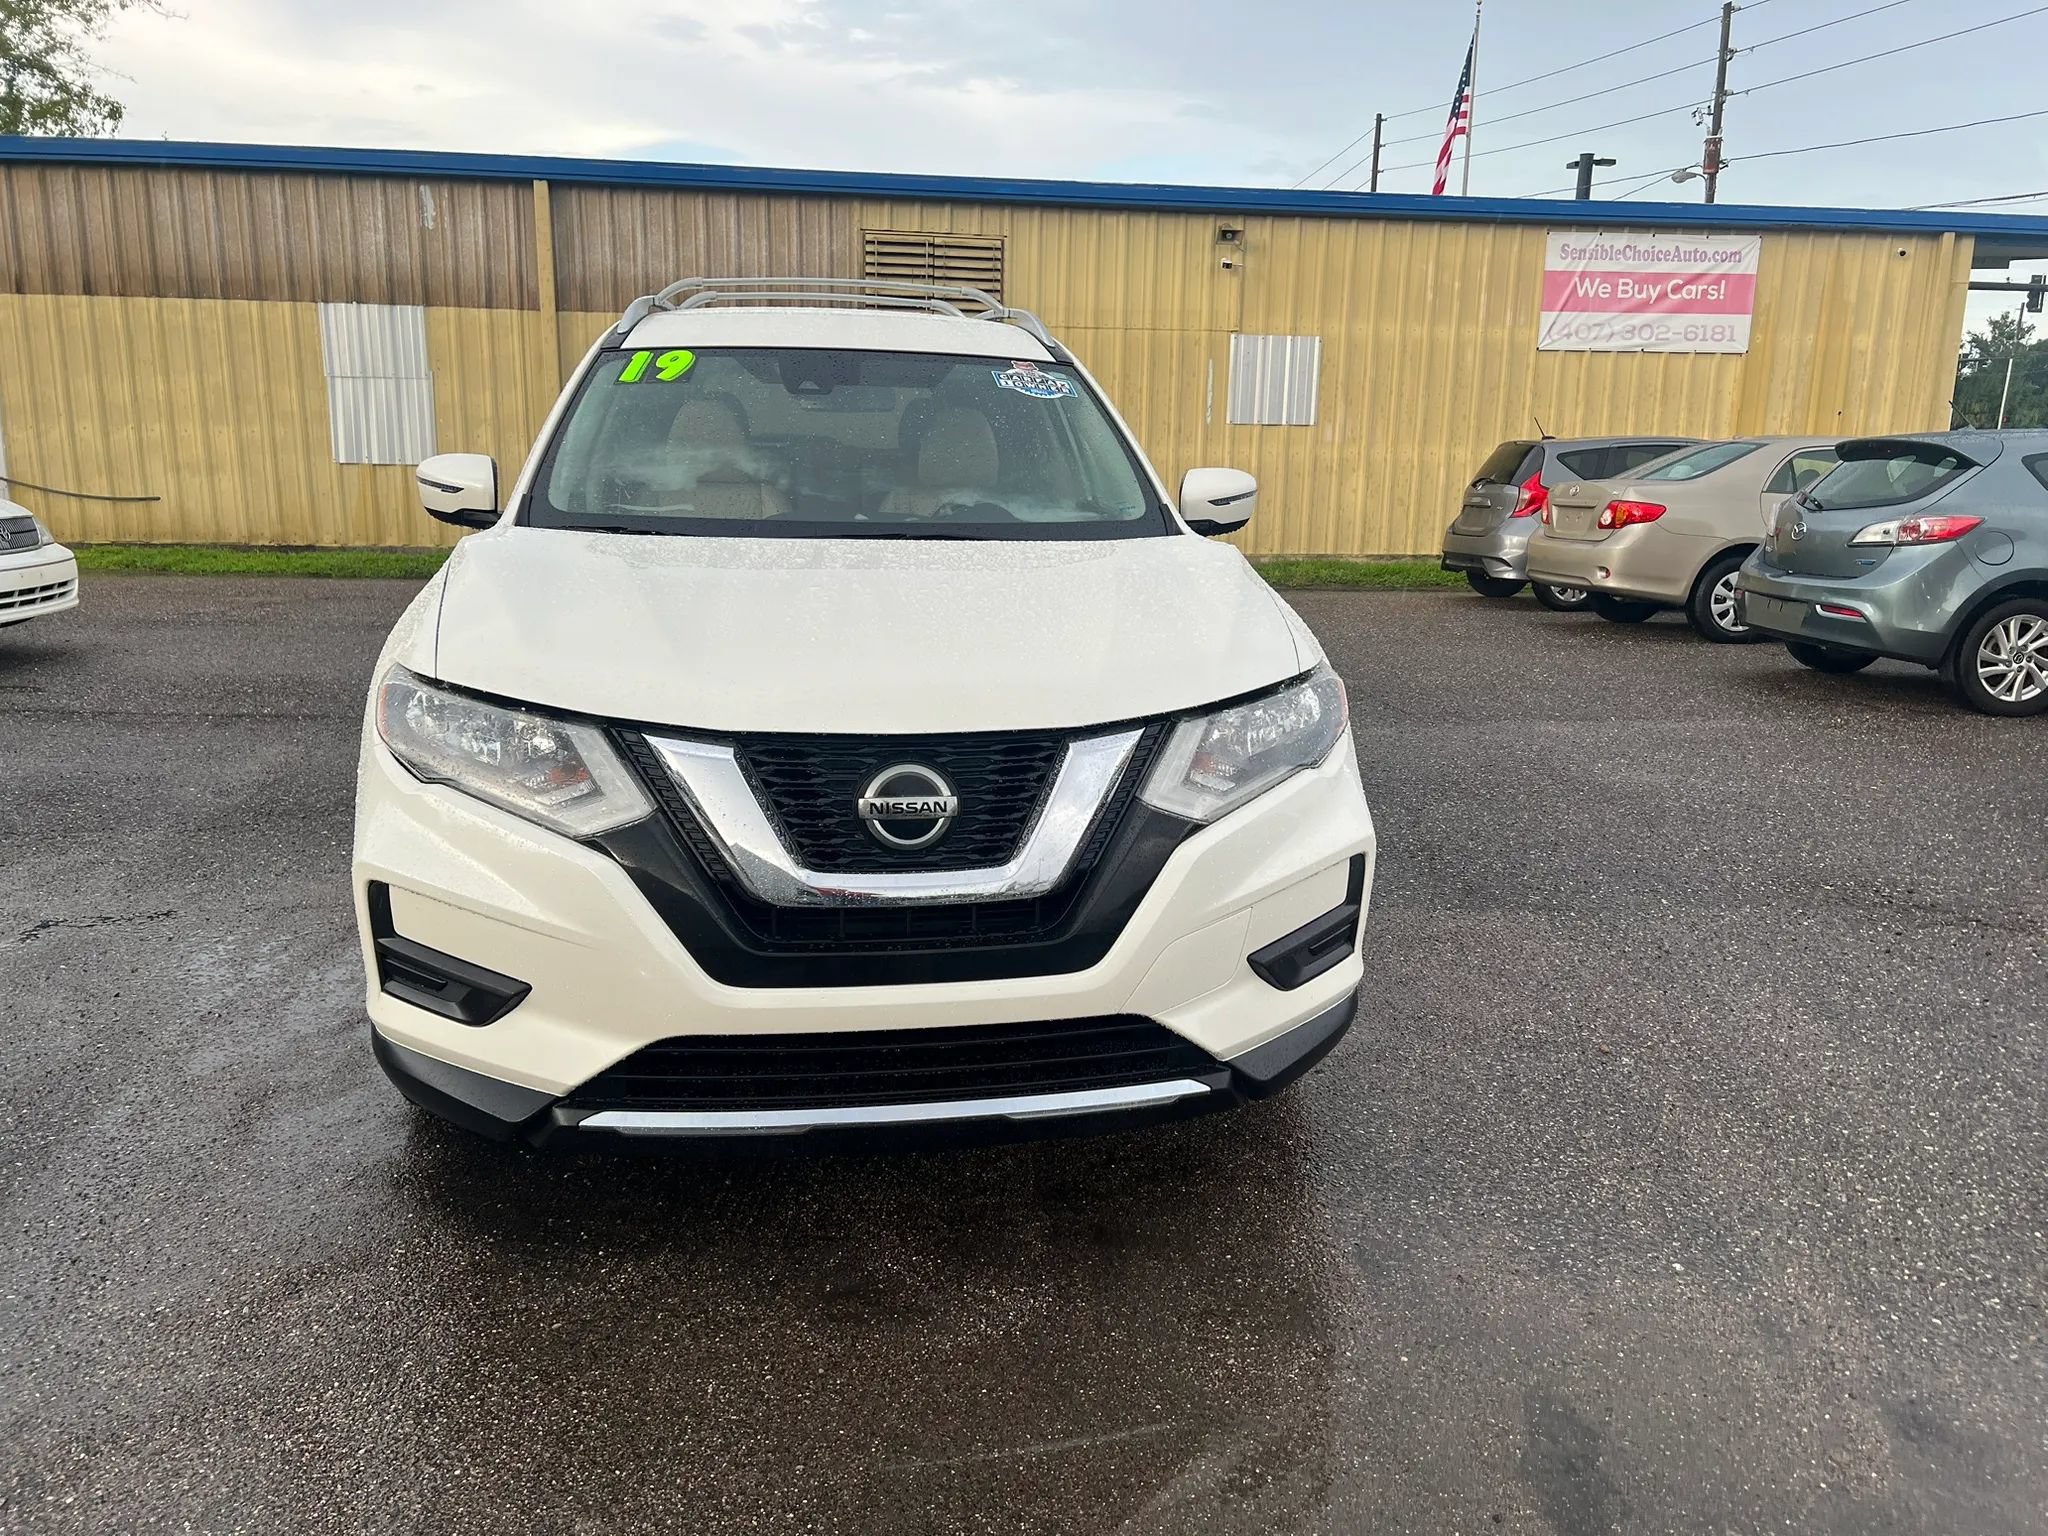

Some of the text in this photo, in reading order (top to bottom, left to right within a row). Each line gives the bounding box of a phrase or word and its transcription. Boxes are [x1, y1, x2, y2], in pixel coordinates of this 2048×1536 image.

[1560, 243, 1742, 263] SensibleChoiceAuto.com
[1575, 277, 1725, 304] We Buy Cars!
[1548, 321, 1736, 343] (407) 302-6181
[618, 350, 696, 382] 19
[869, 801, 947, 815] NISSAN
